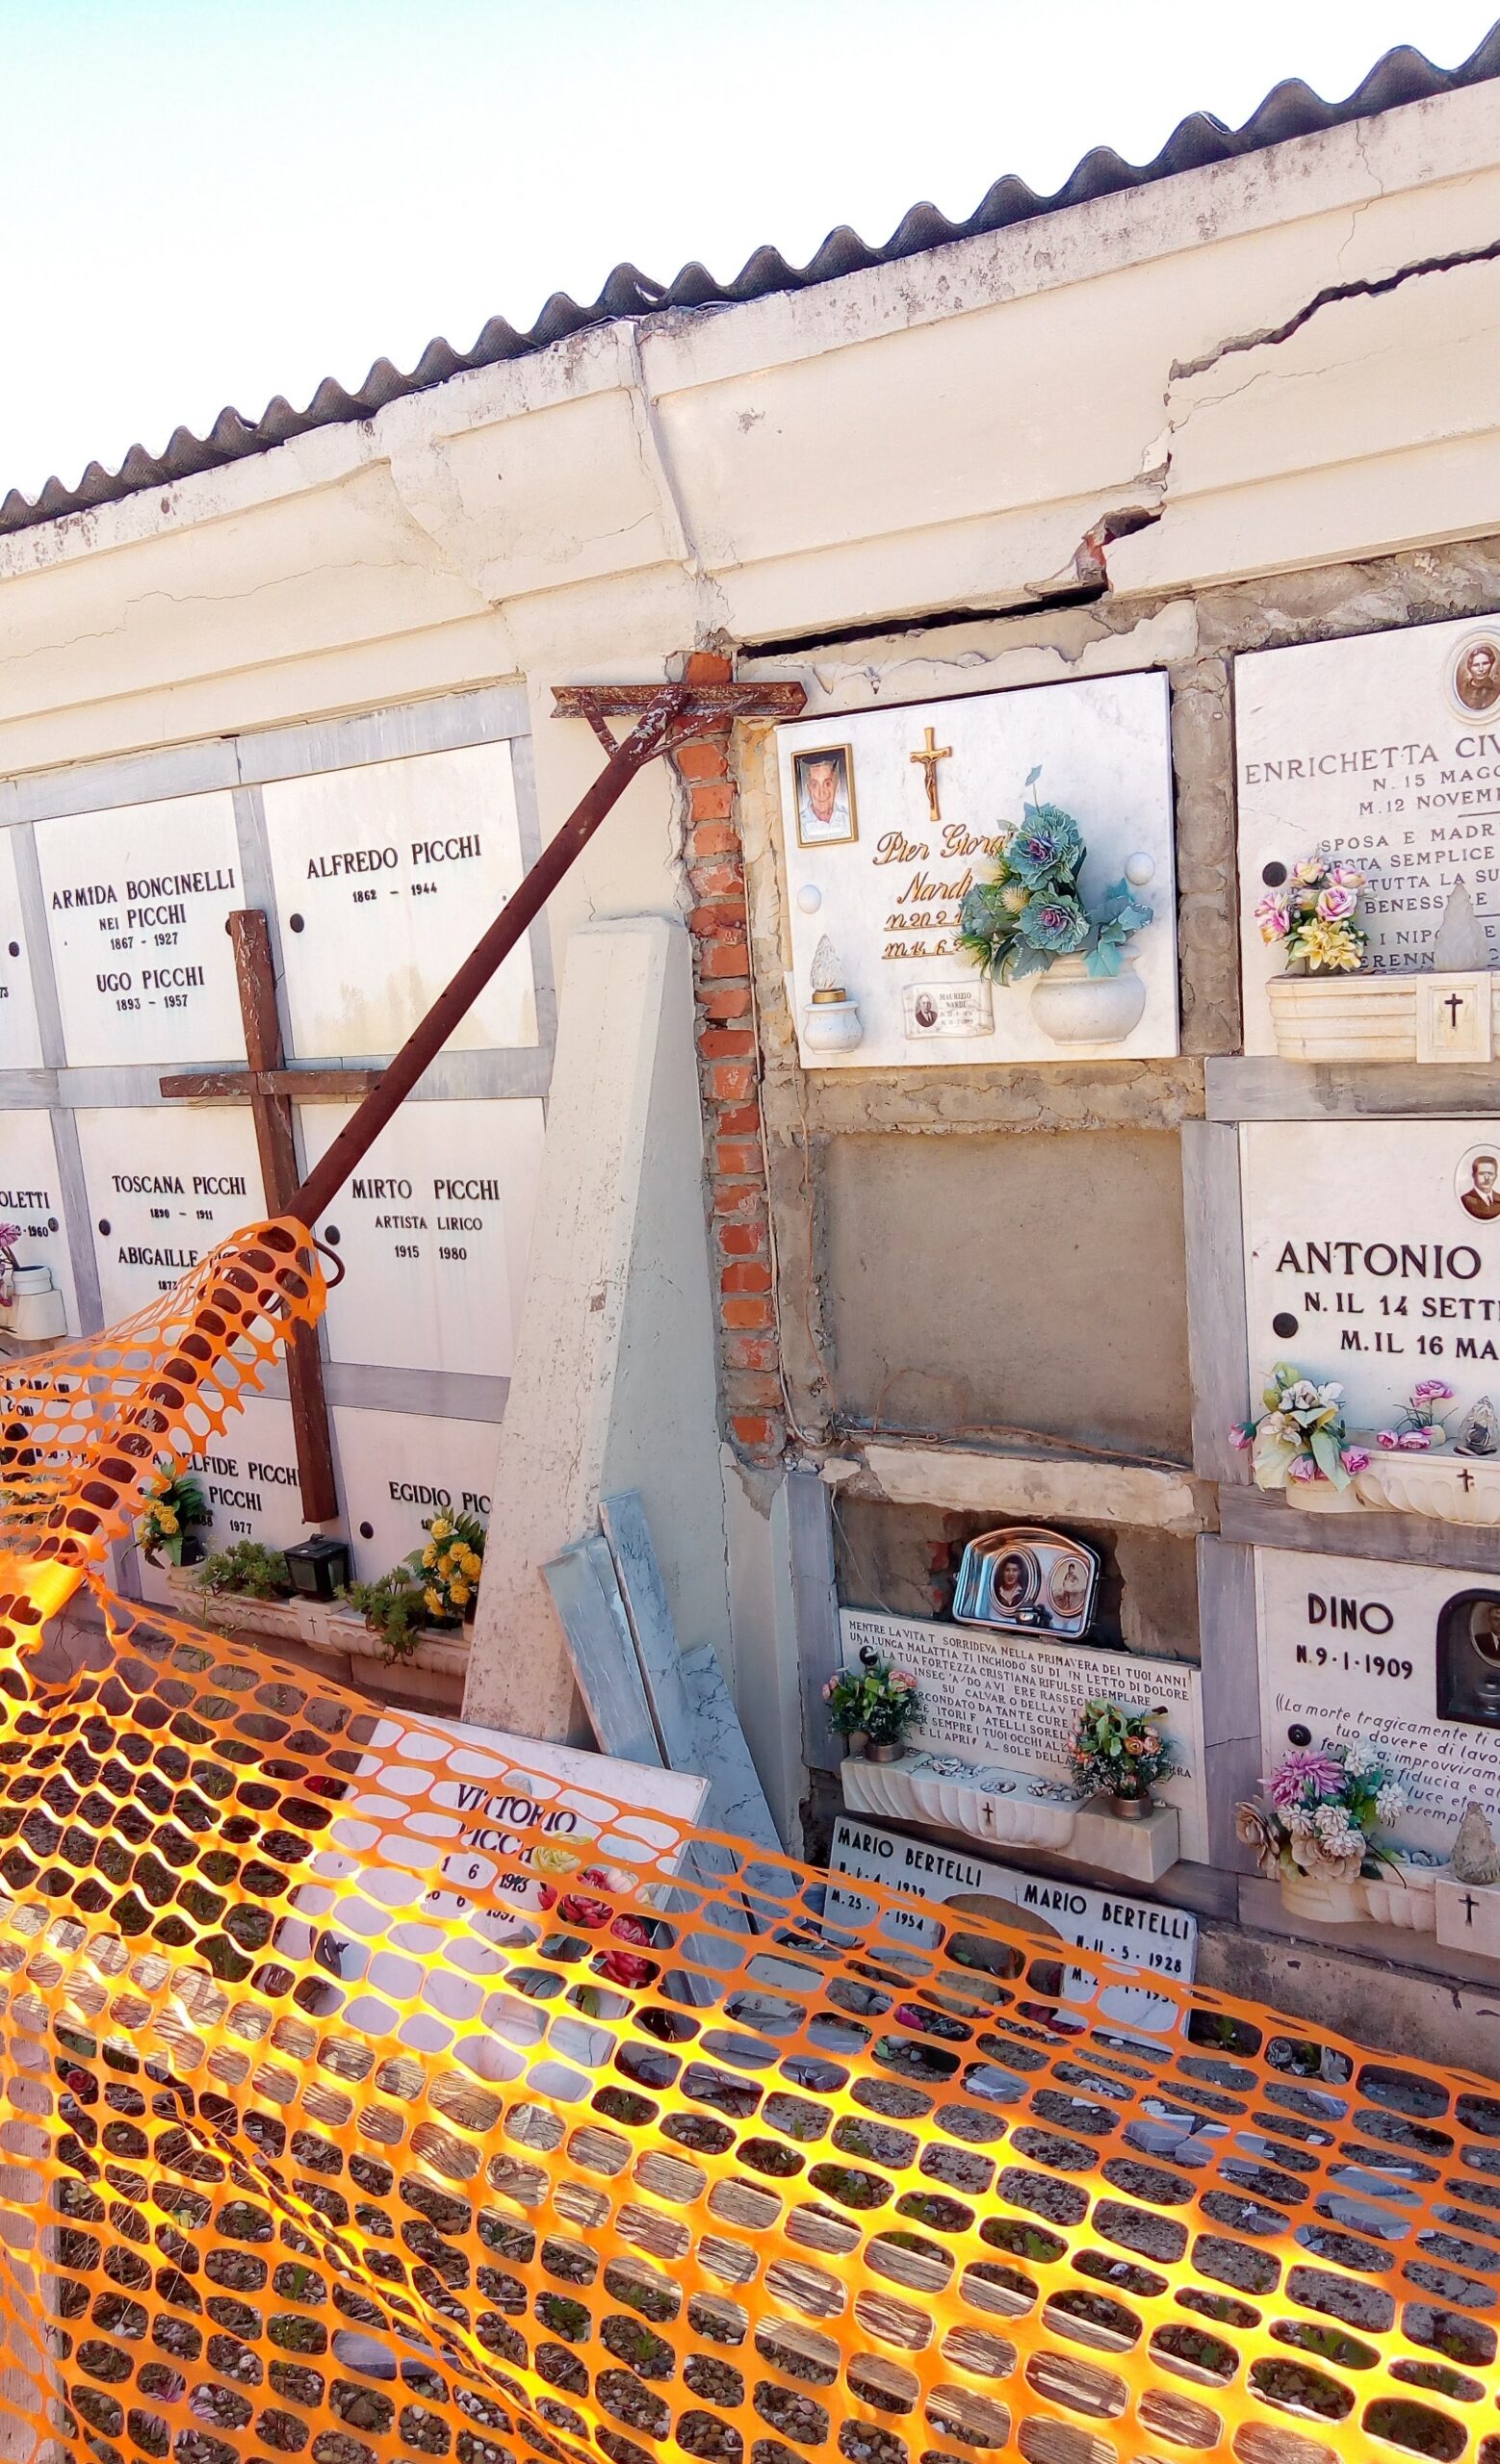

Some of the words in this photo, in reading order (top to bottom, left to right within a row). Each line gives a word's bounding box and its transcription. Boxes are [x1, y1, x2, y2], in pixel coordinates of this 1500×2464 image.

[1245, 743, 1439, 785] ENRICHETTA
[1405, 774, 1426, 788] 15
[872, 831, 930, 865] Pier
[1321, 835, 1389, 853] SPOSA
[1403, 831, 1415, 845] E
[306, 847, 399, 880] ALFREDO
[411, 834, 481, 865] PICCHI
[1390, 846, 1495, 868] SEMPLICE
[52, 885, 118, 910] ARMIDA
[126, 868, 236, 900] BONCINELLI
[352, 888, 377, 903] 1862
[410, 882, 437, 896] 1944
[1369, 876, 1431, 893] TUTTA
[1440, 872, 1465, 886] LA
[98, 917, 119, 931] NEI
[127, 903, 187, 929] PICCHI
[110, 937, 134, 950] 1867
[154, 932, 179, 947] 1927
[96, 972, 132, 992] UGO
[142, 965, 205, 989] PICCHI
[116, 998, 142, 1012] 1893
[164, 994, 189, 1009] 1957
[112, 1175, 185, 1194] TOSCANA
[193, 1176, 247, 1195] PICCHI
[351, 1179, 412, 1199] MIRTO
[434, 1179, 501, 1200] PICCHI
[195, 1210, 214, 1220] 1911
[375, 1216, 428, 1230] ARTISTA
[437, 1217, 483, 1231] LIRICO
[118, 1246, 199, 1268] ABIGAILLE
[395, 1245, 420, 1259] 1915
[439, 1246, 467, 1261] 1980
[1275, 1241, 1482, 1280] ANTONIO
[1380, 1296, 1409, 1316] 14
[1417, 1335, 1444, 1355] 16
[209, 1485, 263, 1511] PICCHI
[388, 1480, 452, 1507] EGIDIO
[230, 1520, 252, 1534] 1977
[1307, 1592, 1394, 1634] DINO
[849, 1621, 885, 1634] MENTRE
[889, 1627, 902, 1638] LA
[902, 1629, 926, 1643] VITA
[943, 1636, 996, 1655] SORRIDEVA
[1001, 1647, 1035, 1661] NELLA
[1102, 1664, 1121, 1676] DEI
[1125, 1668, 1151, 1681] TUOI
[1155, 1674, 1187, 1688] ANNI
[882, 1650, 895, 1660] LA
[898, 1652, 920, 1665] TUA
[921, 1656, 977, 1675] FORTEZZA
[979, 1667, 1037, 1686] CRISTIANA
[1039, 1678, 1084, 1695] RIFULSE
[1088, 1686, 1152, 1707] ESEMPLARE
[907, 1642, 959, 1660] MALATTIA
[963, 1652, 973, 1662] TI
[1031, 1665, 1045, 1675] SU
[1049, 1668, 1060, 1678] DI
[1086, 1674, 1125, 1689] LETTO
[1129, 1681, 1140, 1692] DI
[1144, 1684, 1190, 1701] DOLORE
[978, 1703, 993, 1714] DA
[996, 1706, 1033, 1722] TANTE
[1037, 1715, 1069, 1729] CURE
[1021, 1699, 1056, 1714] DELLA
[932, 1716, 972, 1733] SEMPRE
[982, 1728, 1008, 1741] TUOI
[1011, 1732, 1043, 1748] OCCHI
[1306, 1706, 1352, 1721] morte
[1358, 1710, 1468, 1741] tragicamente
[1475, 1730, 1488, 1745] ti
[919, 1727, 926, 1736] E
[929, 1729, 941, 1739] LI
[1003, 1745, 1032, 1758] SOLE
[1336, 1723, 1360, 1739] tuo
[1369, 1731, 1428, 1750] dovere
[1437, 1743, 1454, 1756] di
[1398, 1767, 1460, 1791] fiducia
[1468, 1784, 1478, 1794] e
[1408, 1785, 1443, 1804] luce
[838, 1826, 894, 1859] MARIO
[905, 1847, 982, 1888] BERTELLI
[468, 1863, 479, 1880] 6
[895, 1911, 924, 1932] 1954
[1023, 1884, 1087, 1914] MARIO
[1101, 1902, 1190, 1940] BERTELLI
[1122, 1946, 1129, 1960] 5
[1149, 1952, 1182, 1973] 1928
